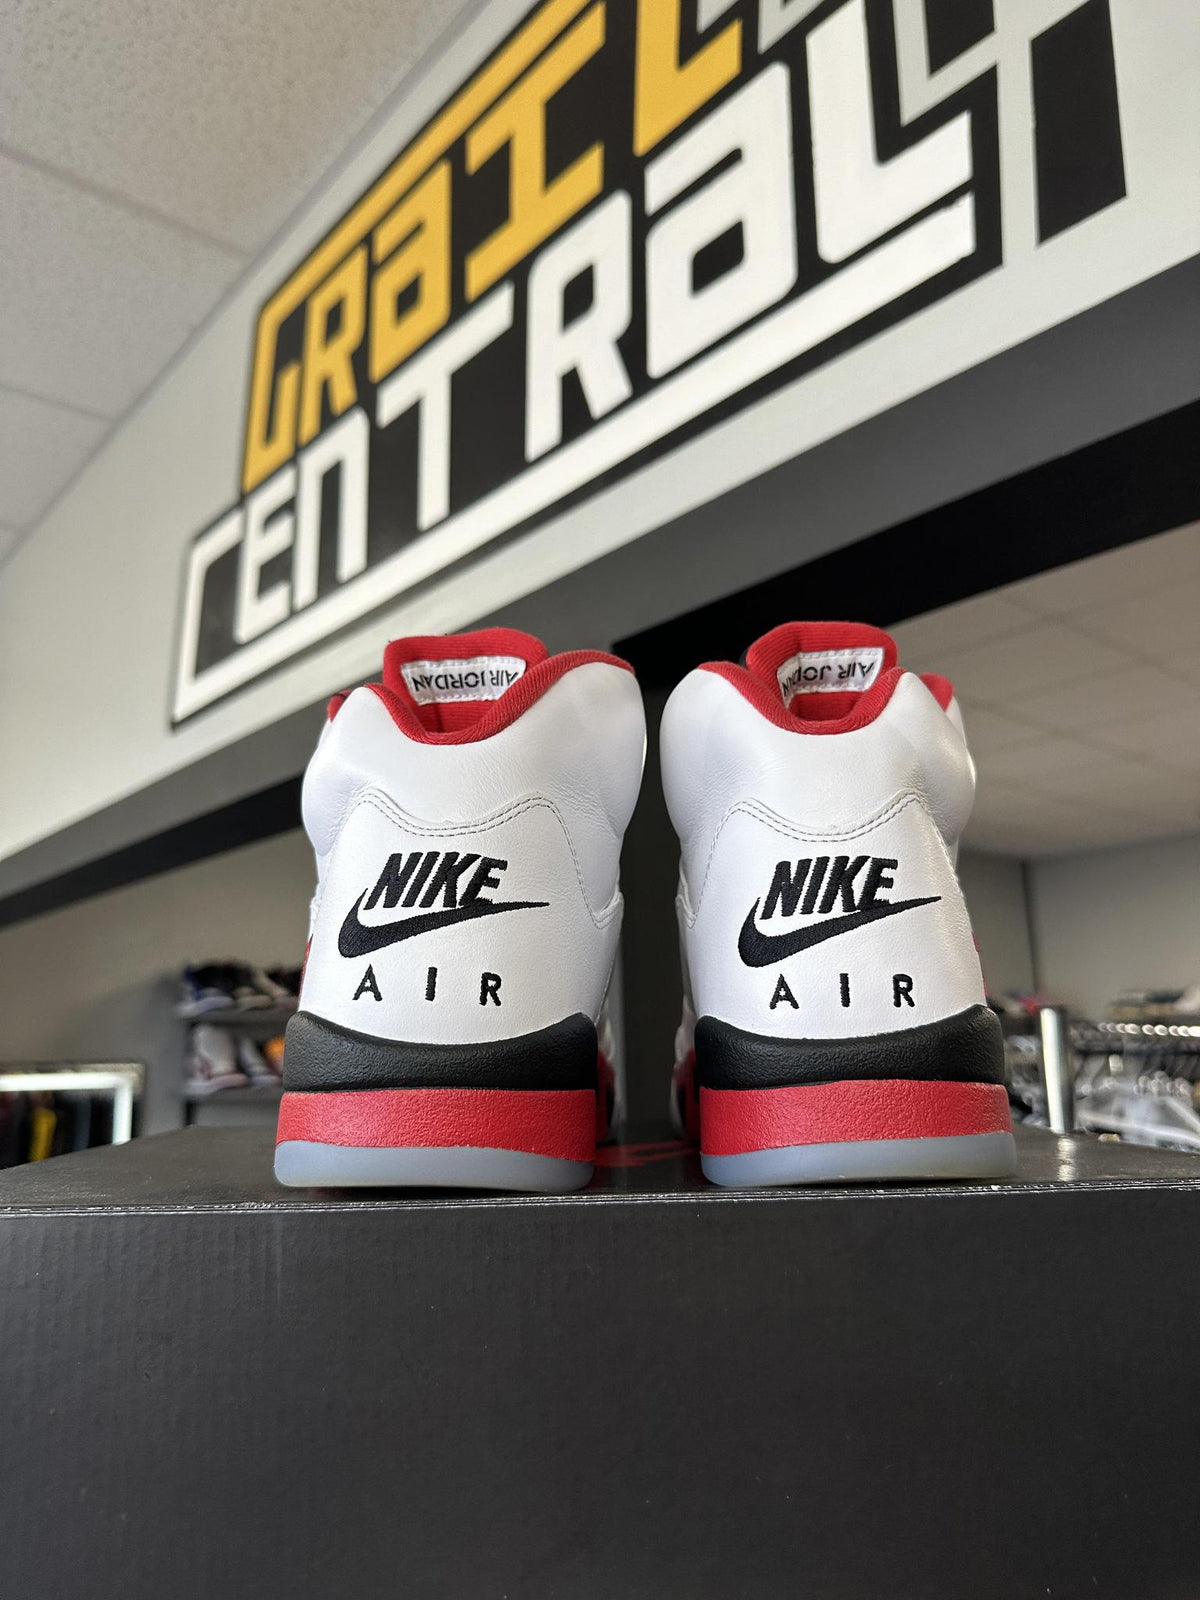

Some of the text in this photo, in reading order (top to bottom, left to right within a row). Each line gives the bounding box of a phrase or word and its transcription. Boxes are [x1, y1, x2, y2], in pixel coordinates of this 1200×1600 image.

[411, 669, 518, 692] AIR JORDAN
[838, 662, 874, 680] AIR
[362, 850, 508, 911] NIKE
[760, 854, 899, 921] NIKE
[353, 963, 502, 1007] AIR
[769, 972, 916, 1010] AIR
